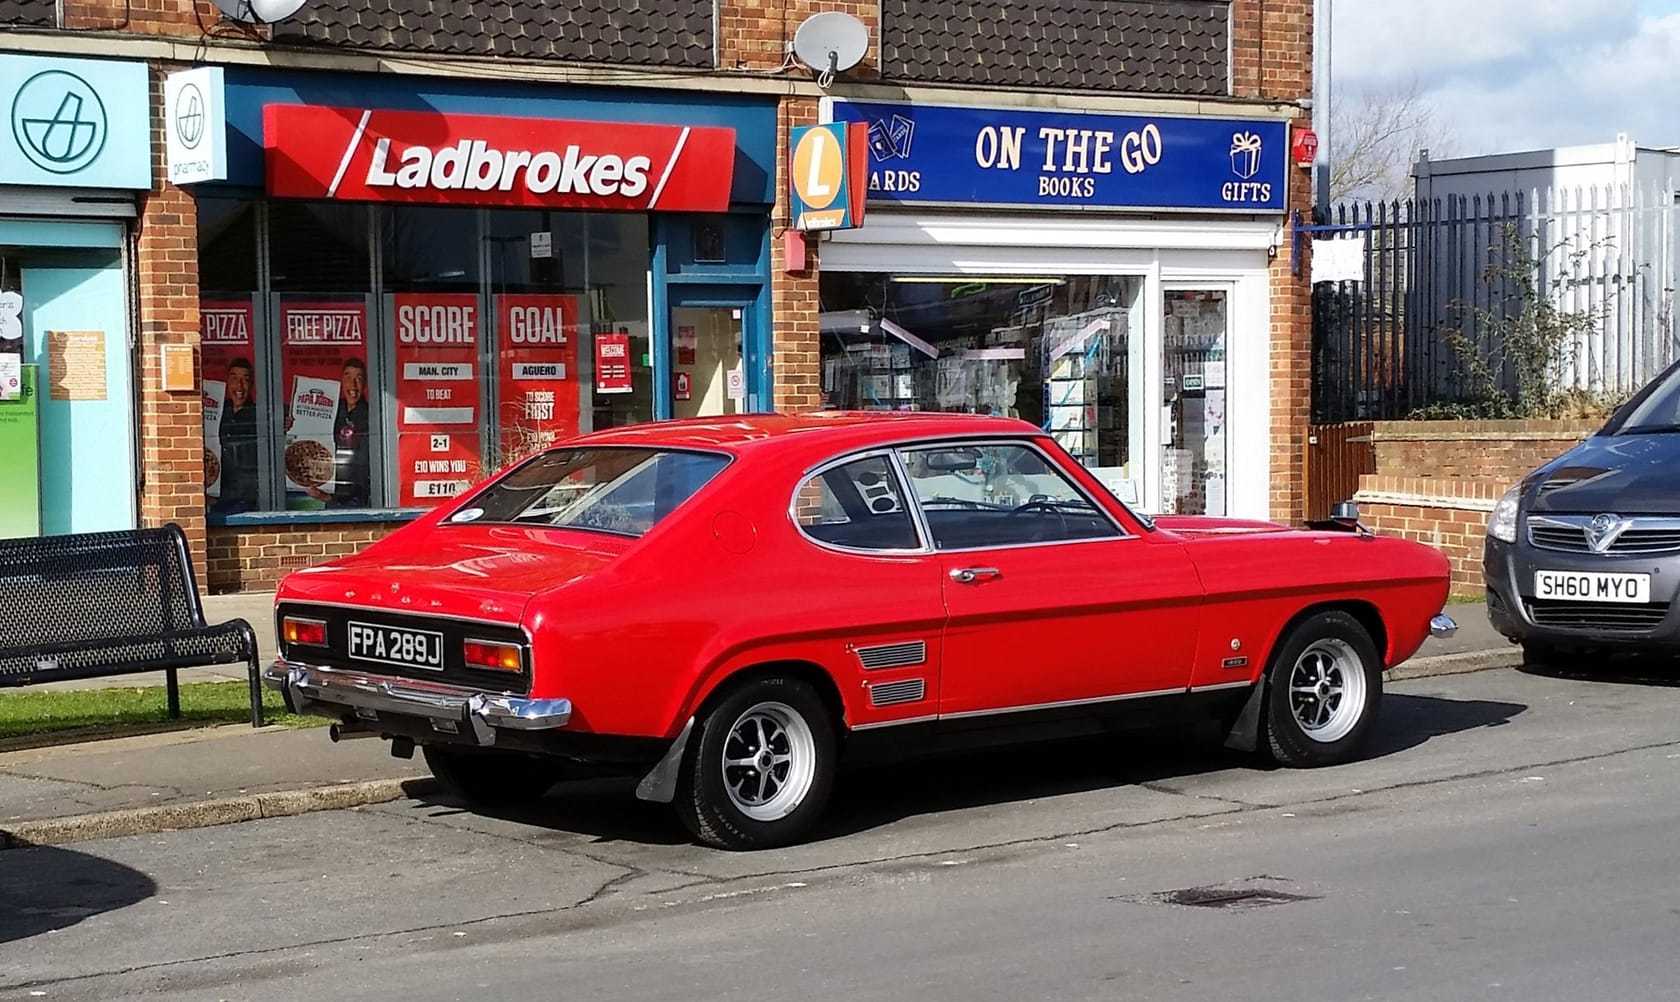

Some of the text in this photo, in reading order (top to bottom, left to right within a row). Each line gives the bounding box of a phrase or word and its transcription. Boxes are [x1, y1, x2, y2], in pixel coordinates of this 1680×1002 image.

[976, 123, 1163, 174] ON THE GO
[365, 138, 652, 197] Ladbrokes
[868, 170, 920, 191] ARDS
[1038, 176, 1095, 198] BOOKS
[1222, 182, 1271, 203] GIFTS
[206, 314, 249, 340] PIZZA
[287, 315, 362, 341] FREE PIZZA
[399, 306, 475, 343] SCORE
[510, 307, 567, 343] GOAL
[418, 367, 459, 376] MAN. CITY
[522, 366, 557, 376] AGUERO
[426, 389, 452, 400] TO BEAT
[525, 391, 534, 401] TO
[525, 402, 555, 420] FIRST
[433, 438, 448, 449] 2-1
[415, 460, 466, 473] £10 WINS YOU
[428, 483, 456, 494] £110
[1543, 576, 1590, 596] SH60
[351, 626, 440, 664] FPA 289J
